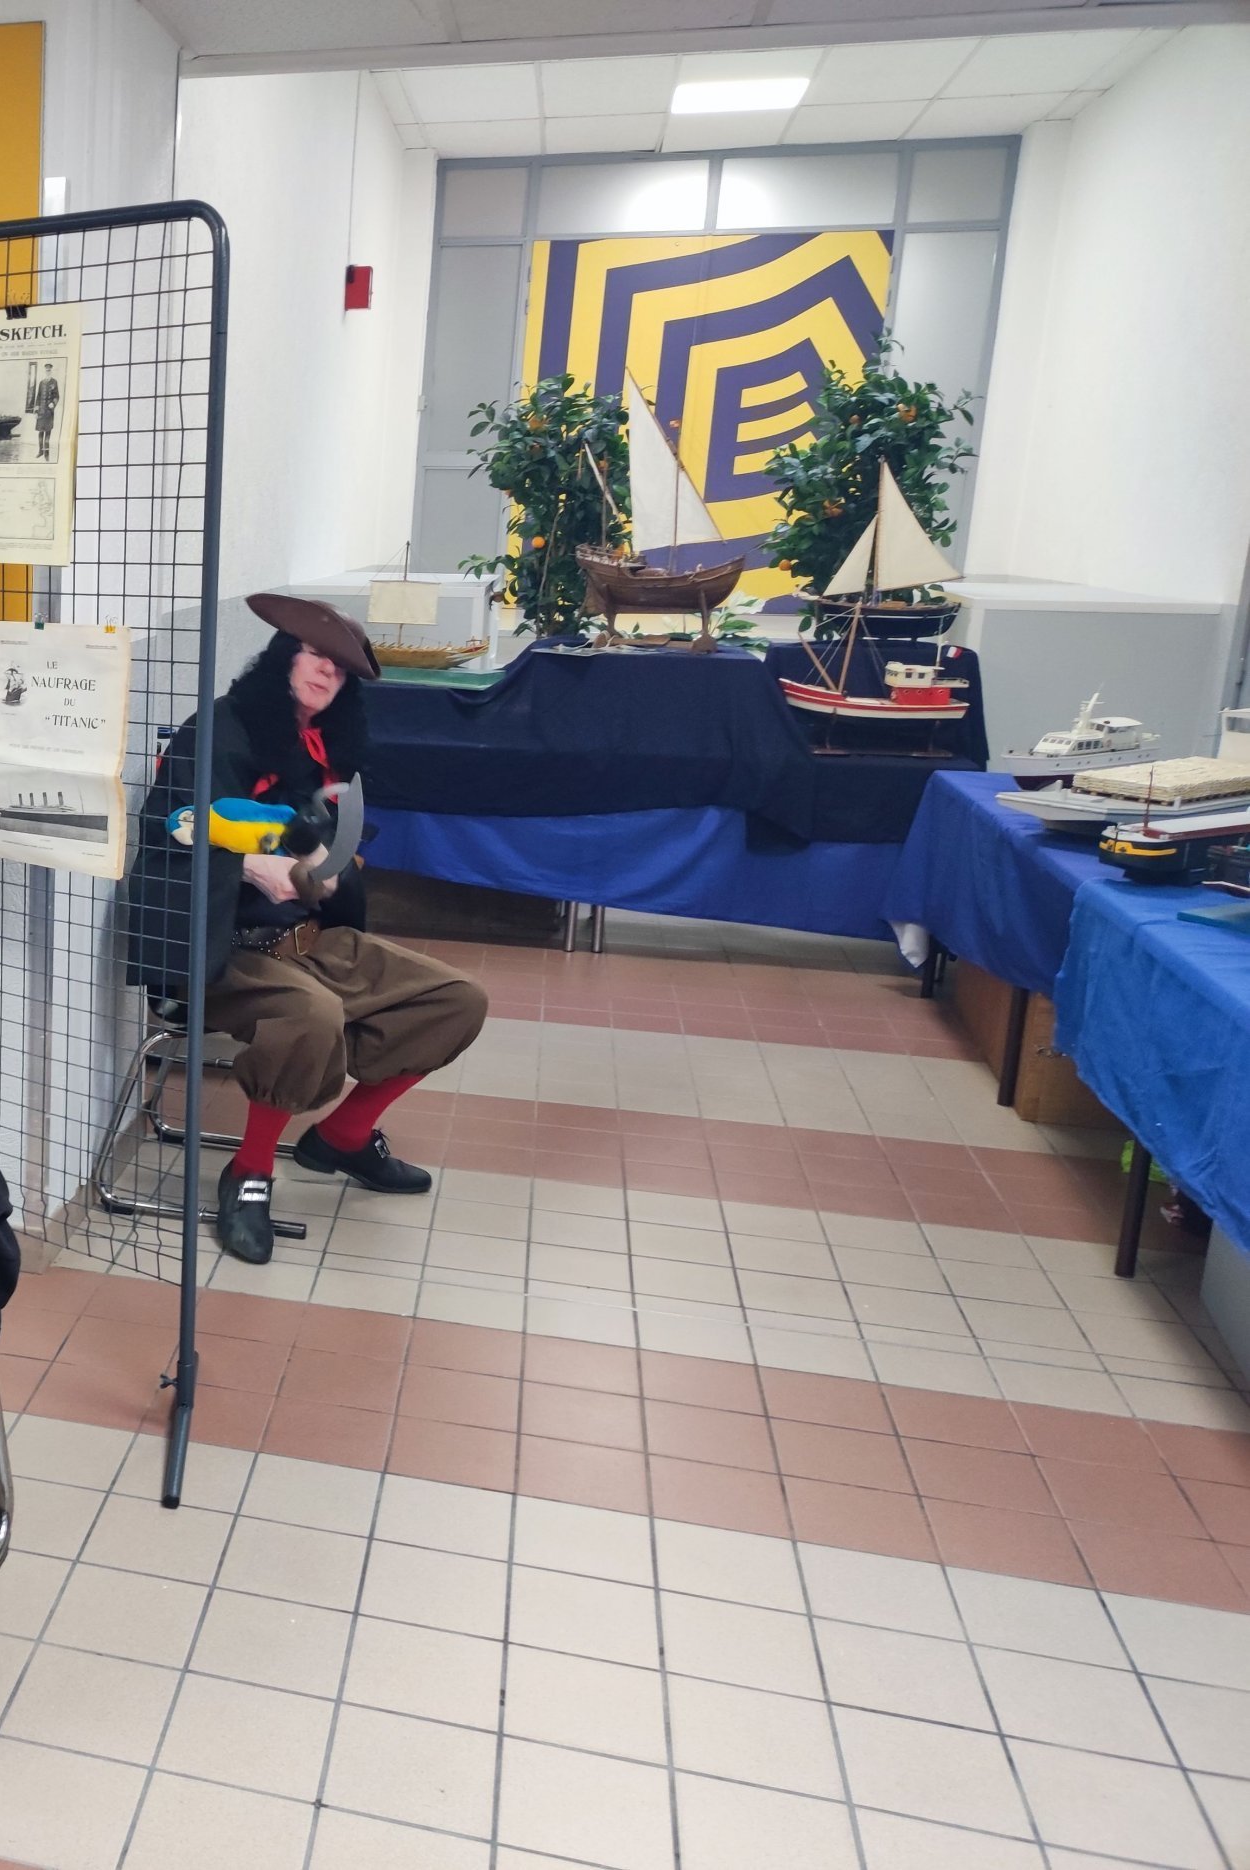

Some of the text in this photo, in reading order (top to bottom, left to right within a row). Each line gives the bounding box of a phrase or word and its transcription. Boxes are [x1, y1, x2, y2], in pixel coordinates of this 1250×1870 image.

[46, 661, 58, 670] LE
[31, 676, 97, 692] NAUFRAGE
[63, 697, 76, 707] DU
